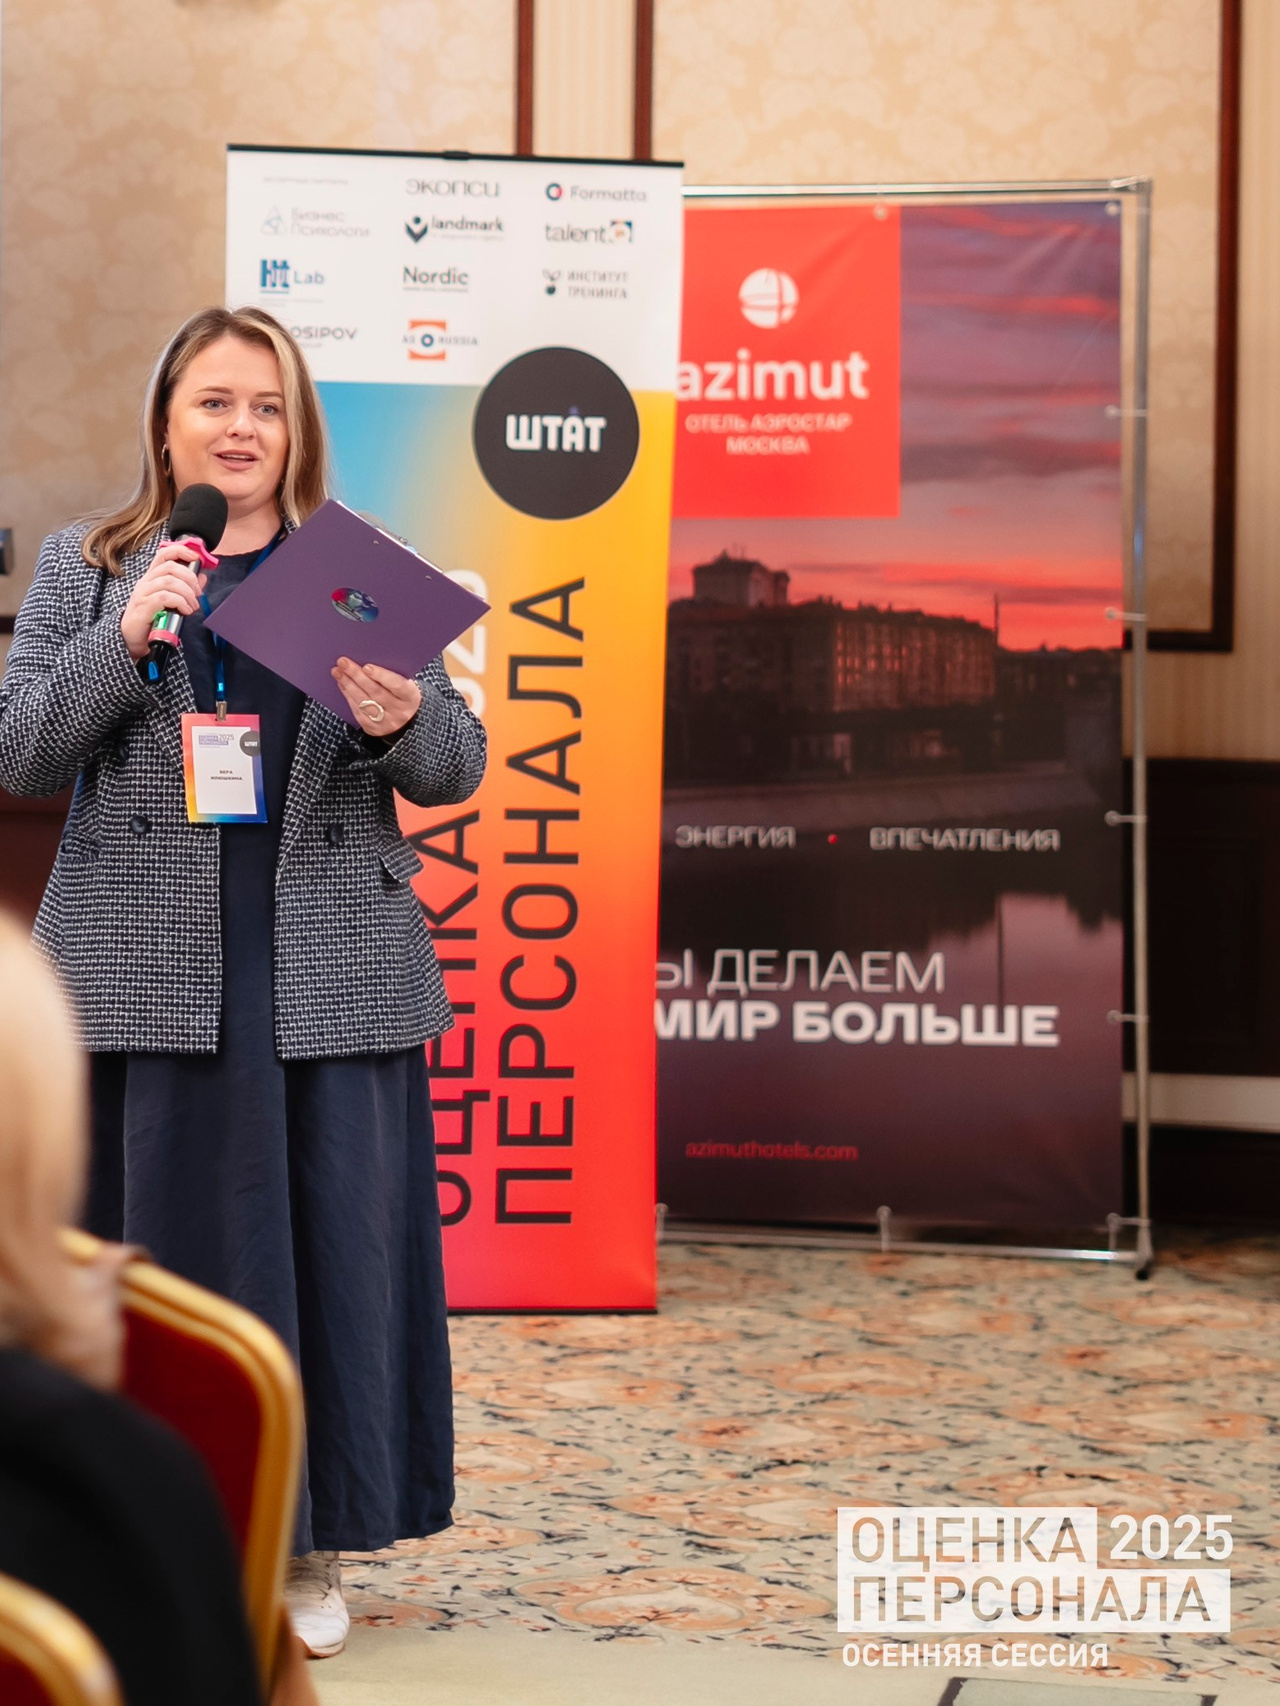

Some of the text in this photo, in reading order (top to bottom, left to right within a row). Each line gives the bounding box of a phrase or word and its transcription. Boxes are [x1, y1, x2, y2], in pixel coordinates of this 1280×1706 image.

[431, 215, 503, 232] landmark
[403, 266, 469, 286] Nordic
[676, 347, 870, 401] azimut
[506, 410, 607, 452] ШТАТ
[685, 413, 853, 433] ОТЕЛЬ АЭРОСТАР
[726, 435, 810, 456] МОСКВА
[675, 825, 796, 848] ЭНЕРГИЯ
[870, 827, 1061, 851] ВПЕЧАТЛЕНИЯ
[495, 577, 586, 1225] ПЕРСОНАЛА
[655, 948, 946, 998] Ы ДЕЛАЕМ
[792, 1001, 1061, 1048] БОЛЬШЕ
[686, 1139, 860, 1162] azimuthotels.com
